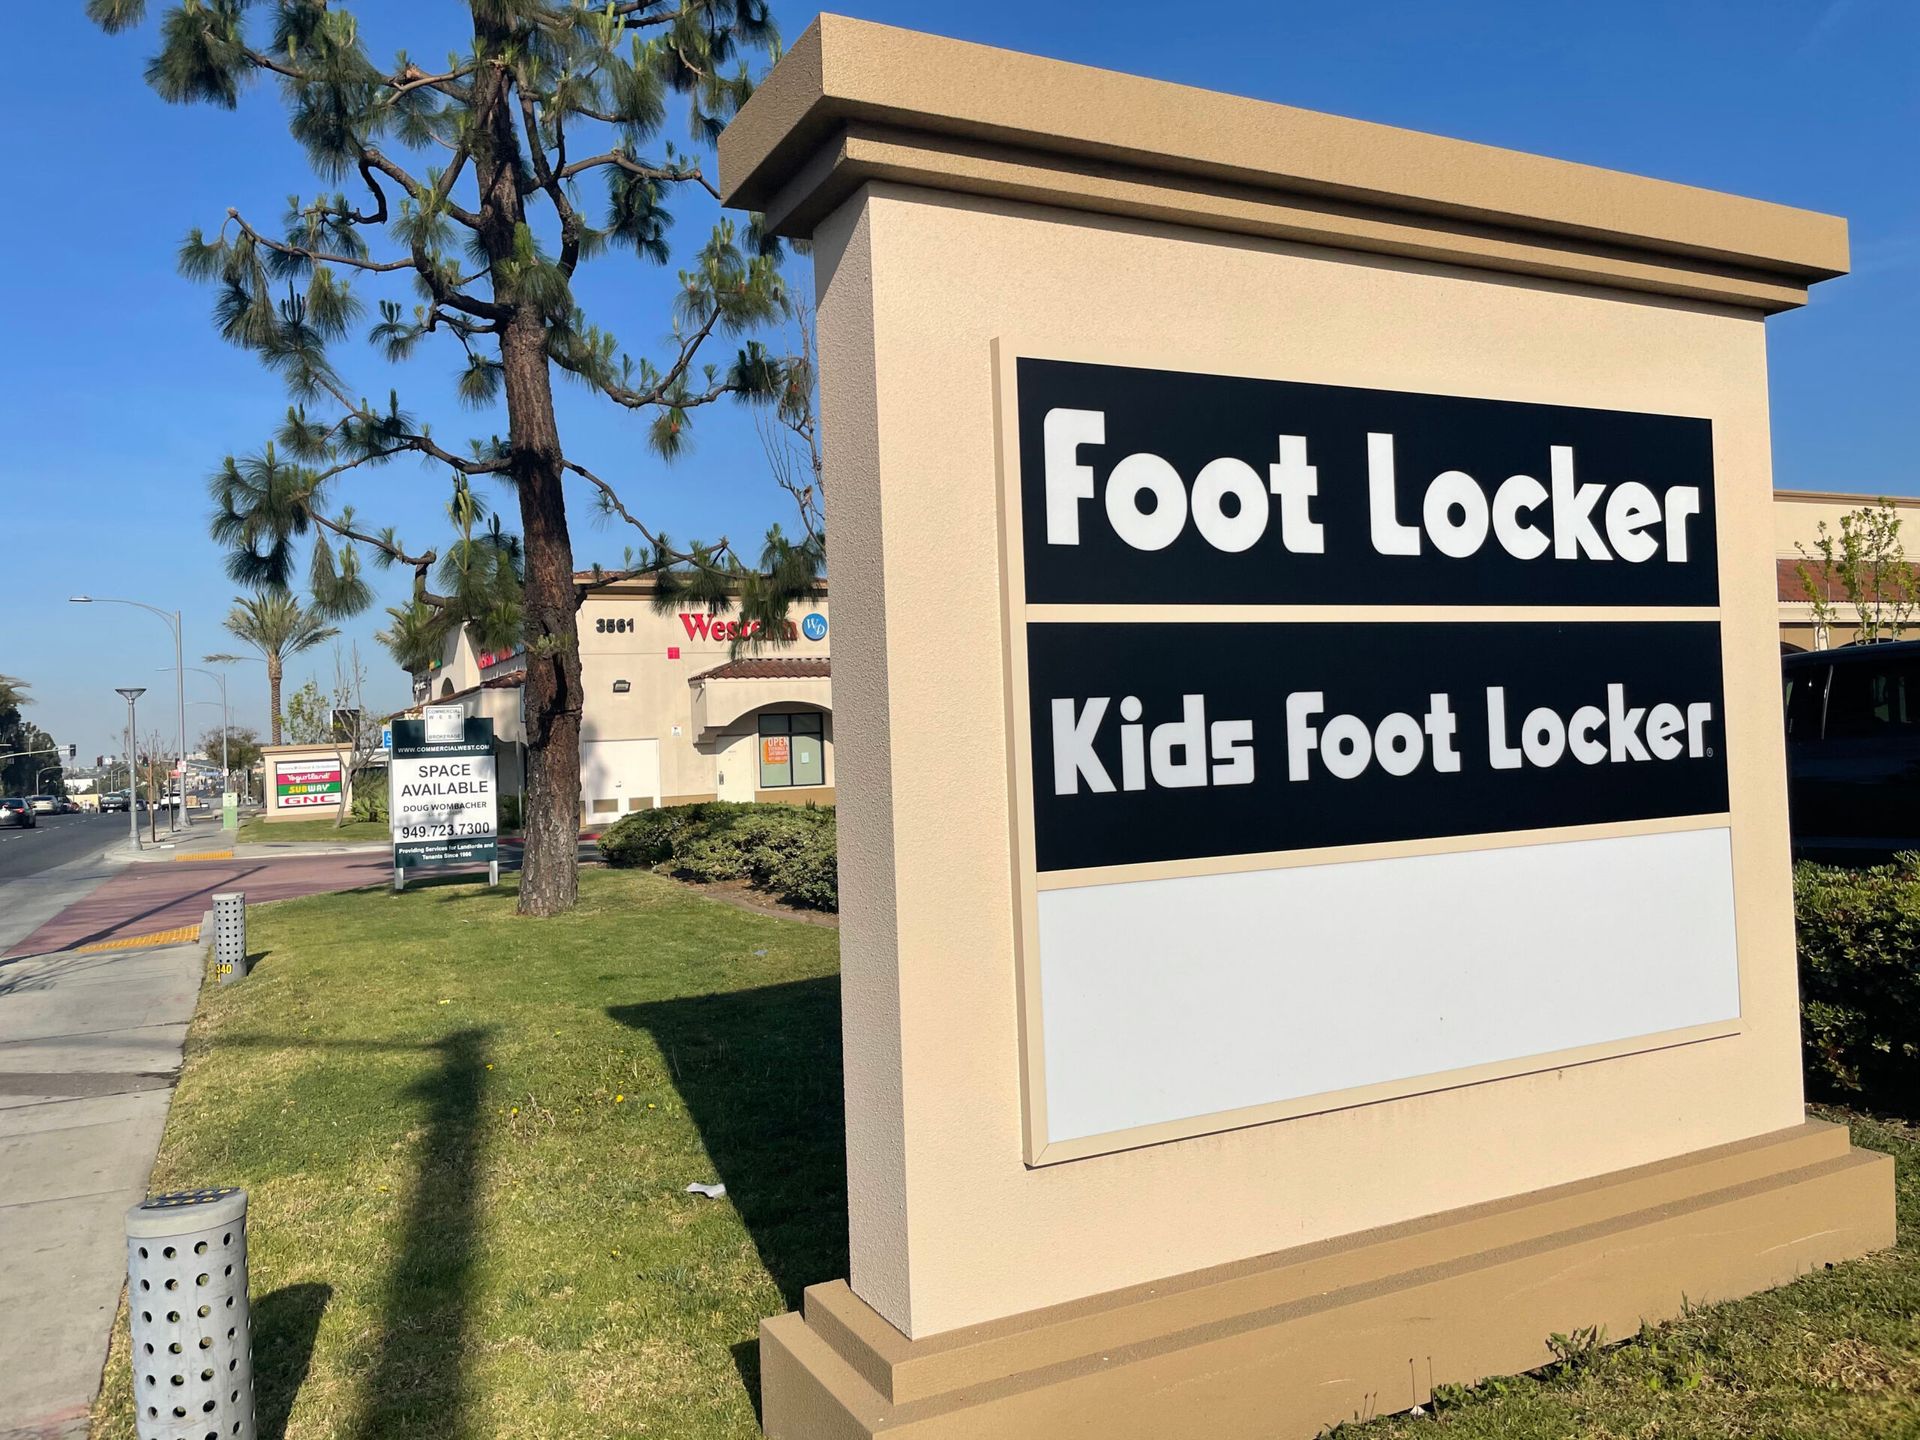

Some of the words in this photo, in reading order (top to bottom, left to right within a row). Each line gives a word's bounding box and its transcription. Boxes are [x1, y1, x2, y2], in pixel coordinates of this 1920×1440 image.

[1044, 407, 1325, 553] Foot
[1367, 432, 1700, 562] Locker
[595, 617, 634, 634] 3561
[1051, 694, 1255, 795] Kids
[1285, 691, 1461, 781] Foot
[1487, 683, 1712, 769] Locker
[397, 744, 490, 753] WWW.COMMERCIALWEST.COM
[418, 763, 471, 778] SPACE
[288, 784, 330, 794] SUBWAY
[401, 780, 489, 797] AVAILABLE
[284, 794, 336, 805] GNC
[403, 804, 429, 812] DOUG
[430, 801, 487, 811] WOMBACHER
[401, 822, 490, 839] 949.723.7300
